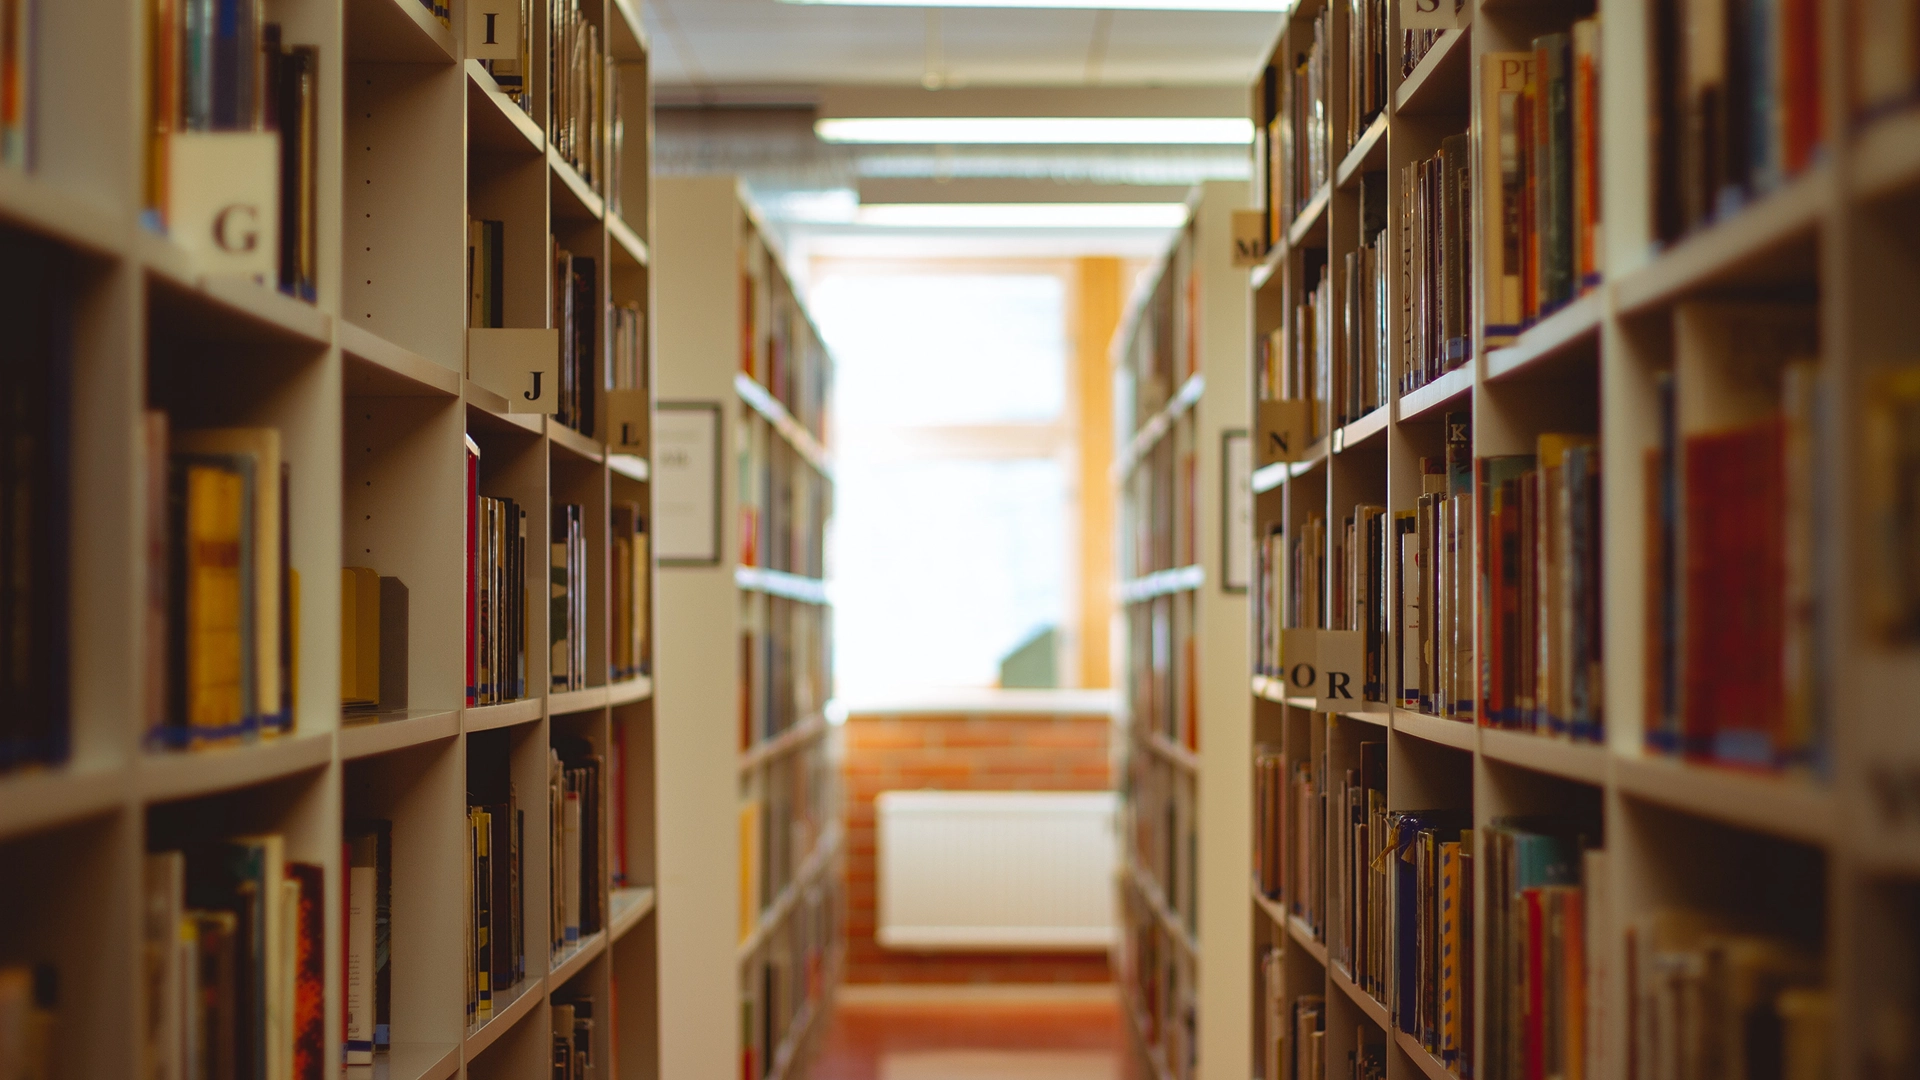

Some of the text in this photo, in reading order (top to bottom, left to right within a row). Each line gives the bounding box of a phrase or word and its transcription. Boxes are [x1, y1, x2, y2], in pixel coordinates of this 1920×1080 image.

[482, 13, 499, 44] I
[211, 203, 259, 255] G
[523, 371, 545, 401] J
[620, 422, 640, 446] L
[1269, 431, 1290, 455] N
[1450, 423, 1467, 441] K
[1291, 662, 1316, 689] O
[1325, 671, 1354, 700] R
